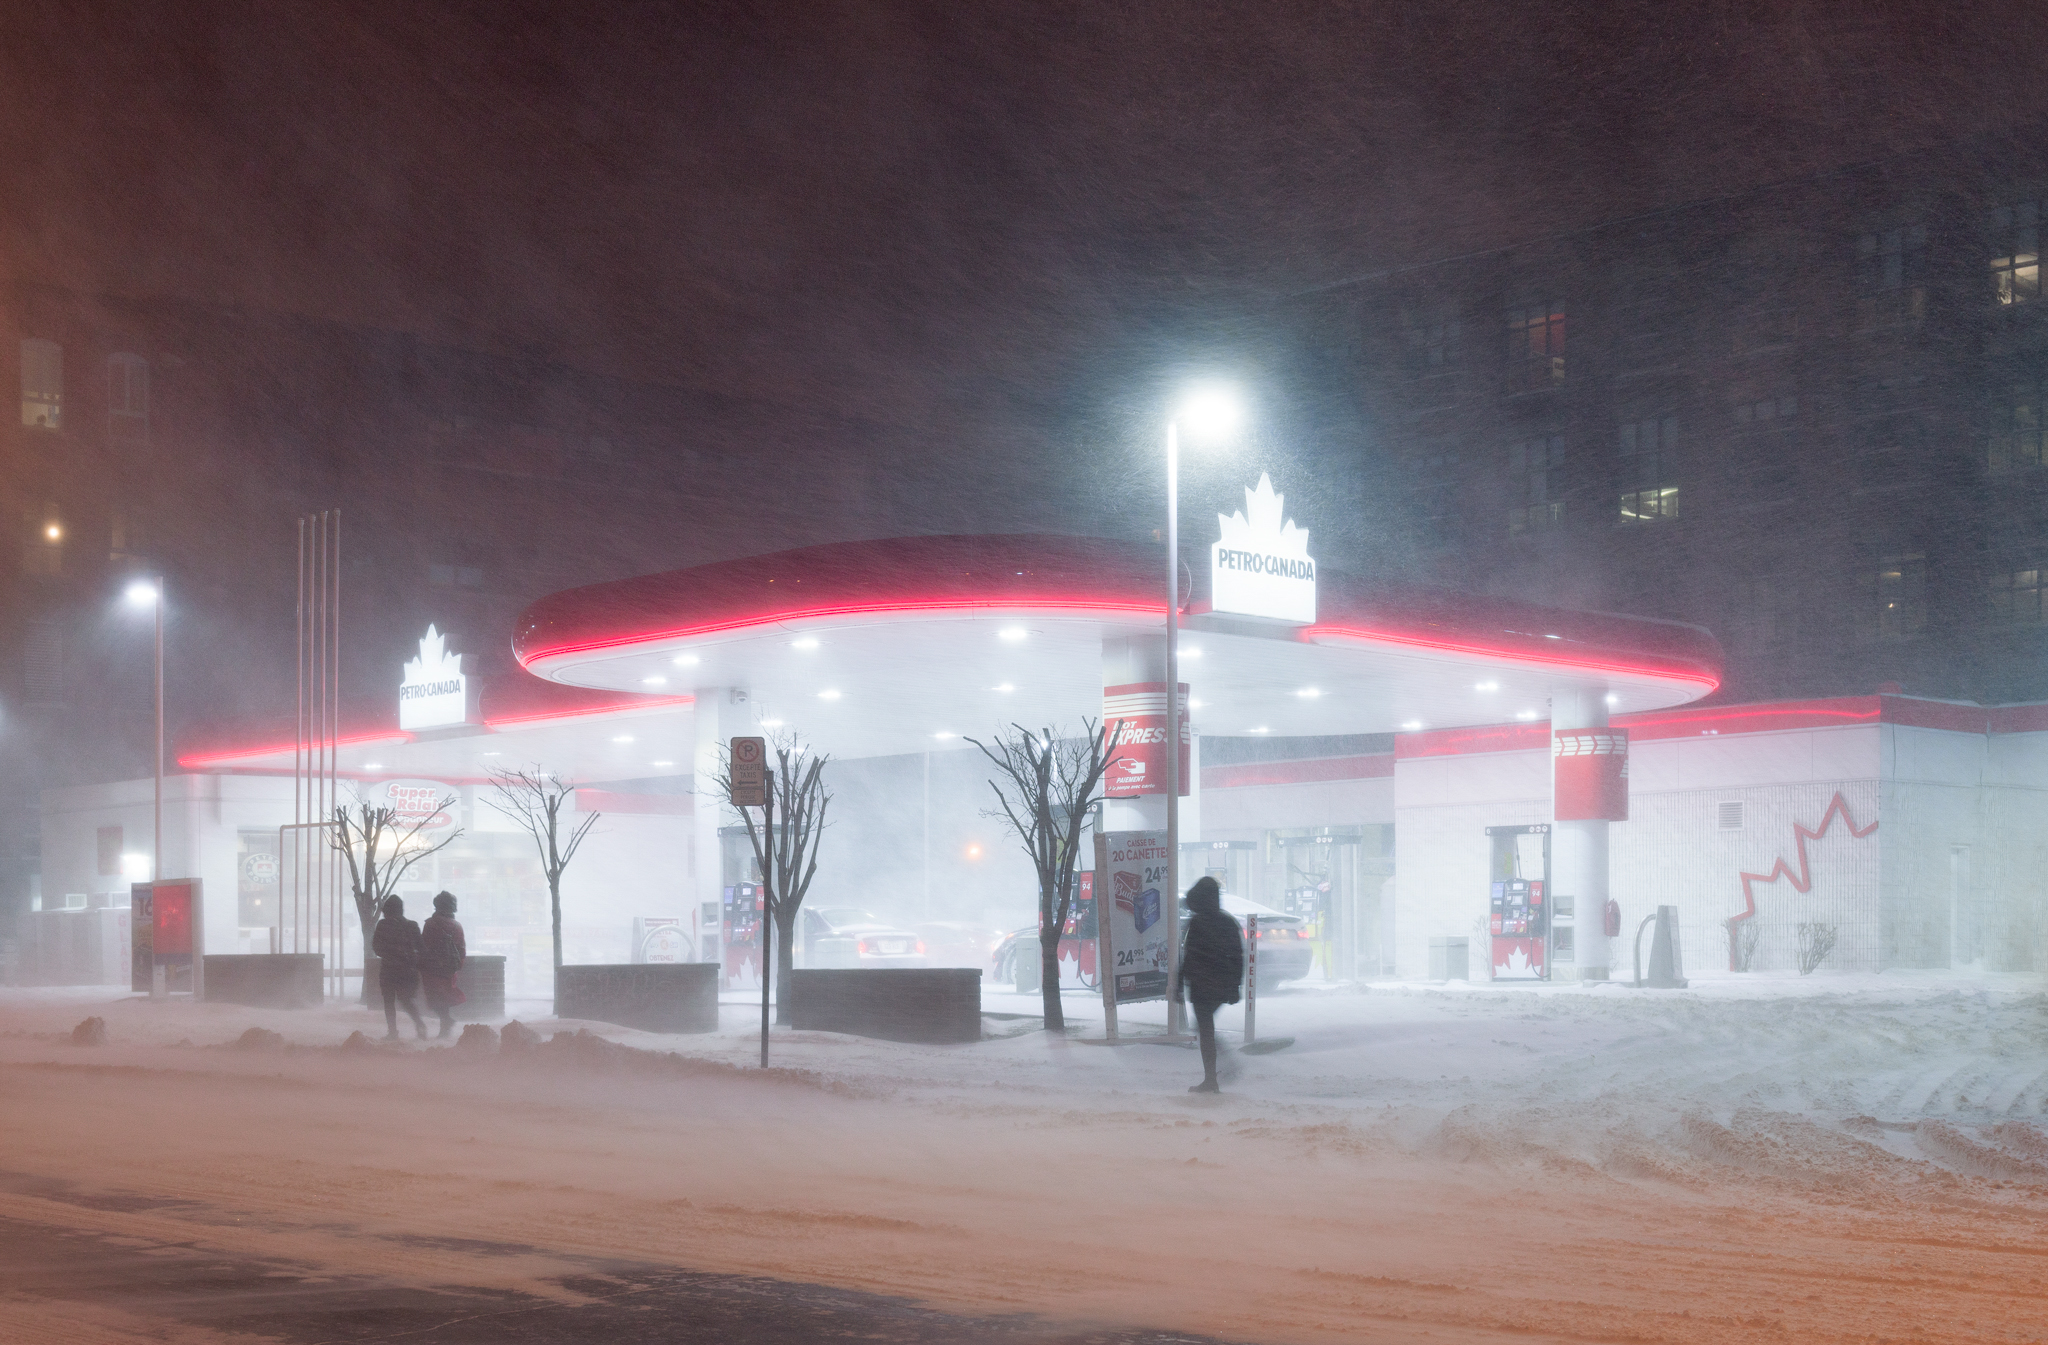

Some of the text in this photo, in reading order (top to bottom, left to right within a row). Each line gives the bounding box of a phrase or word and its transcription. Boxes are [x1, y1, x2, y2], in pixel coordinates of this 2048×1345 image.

[1107, 727, 1168, 747] EXPRES
[1116, 775, 1146, 784] PAIEMENT
[388, 784, 436, 800] Super
[1126, 838, 1156, 848] CAISSE DE
[1112, 846, 1168, 862] 20 CANETTE
[1082, 883, 1091, 891] 94
[649, 954, 674, 962] OBTENEZ
